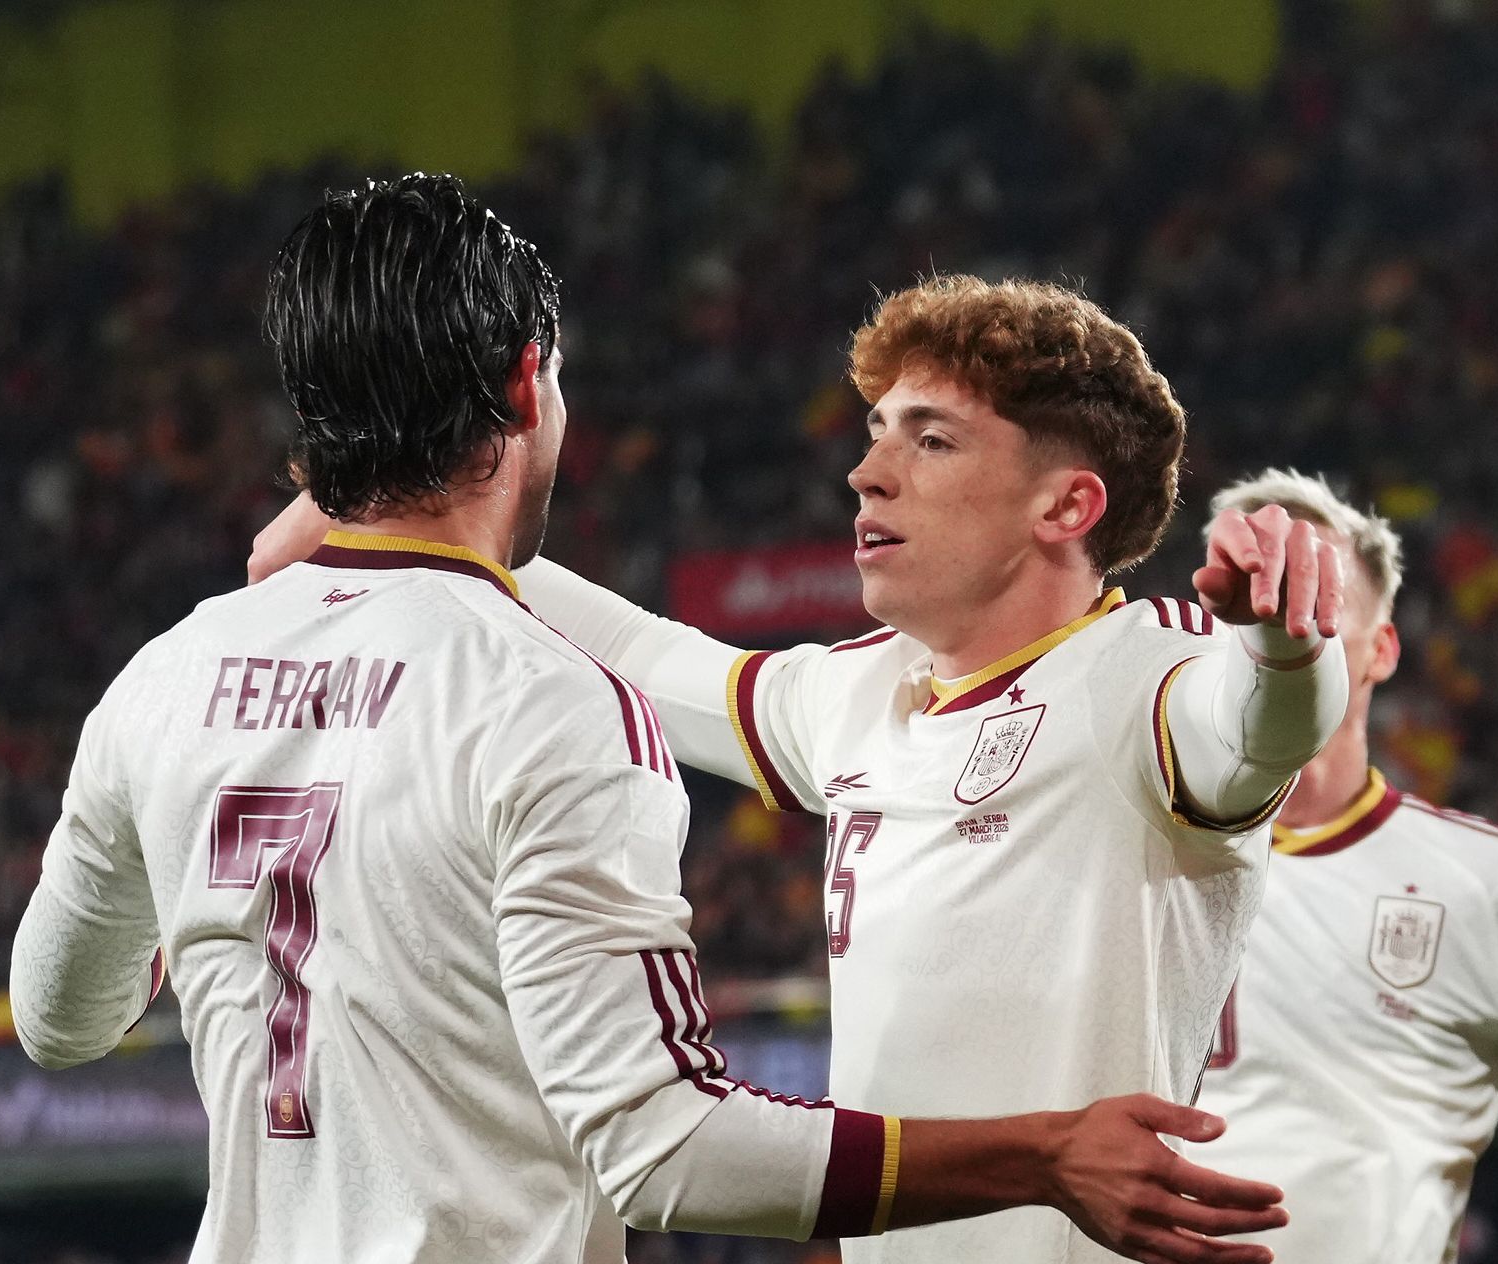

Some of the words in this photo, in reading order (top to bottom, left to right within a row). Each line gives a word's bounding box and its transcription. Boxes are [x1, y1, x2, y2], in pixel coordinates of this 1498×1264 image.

[203, 656, 407, 730] FERRAN
[955, 818, 978, 829] SPAIN
[983, 813, 1009, 824] SERBIA
[958, 827, 967, 837] 27
[969, 824, 992, 835] MARCH
[208, 781, 343, 1139] 7
